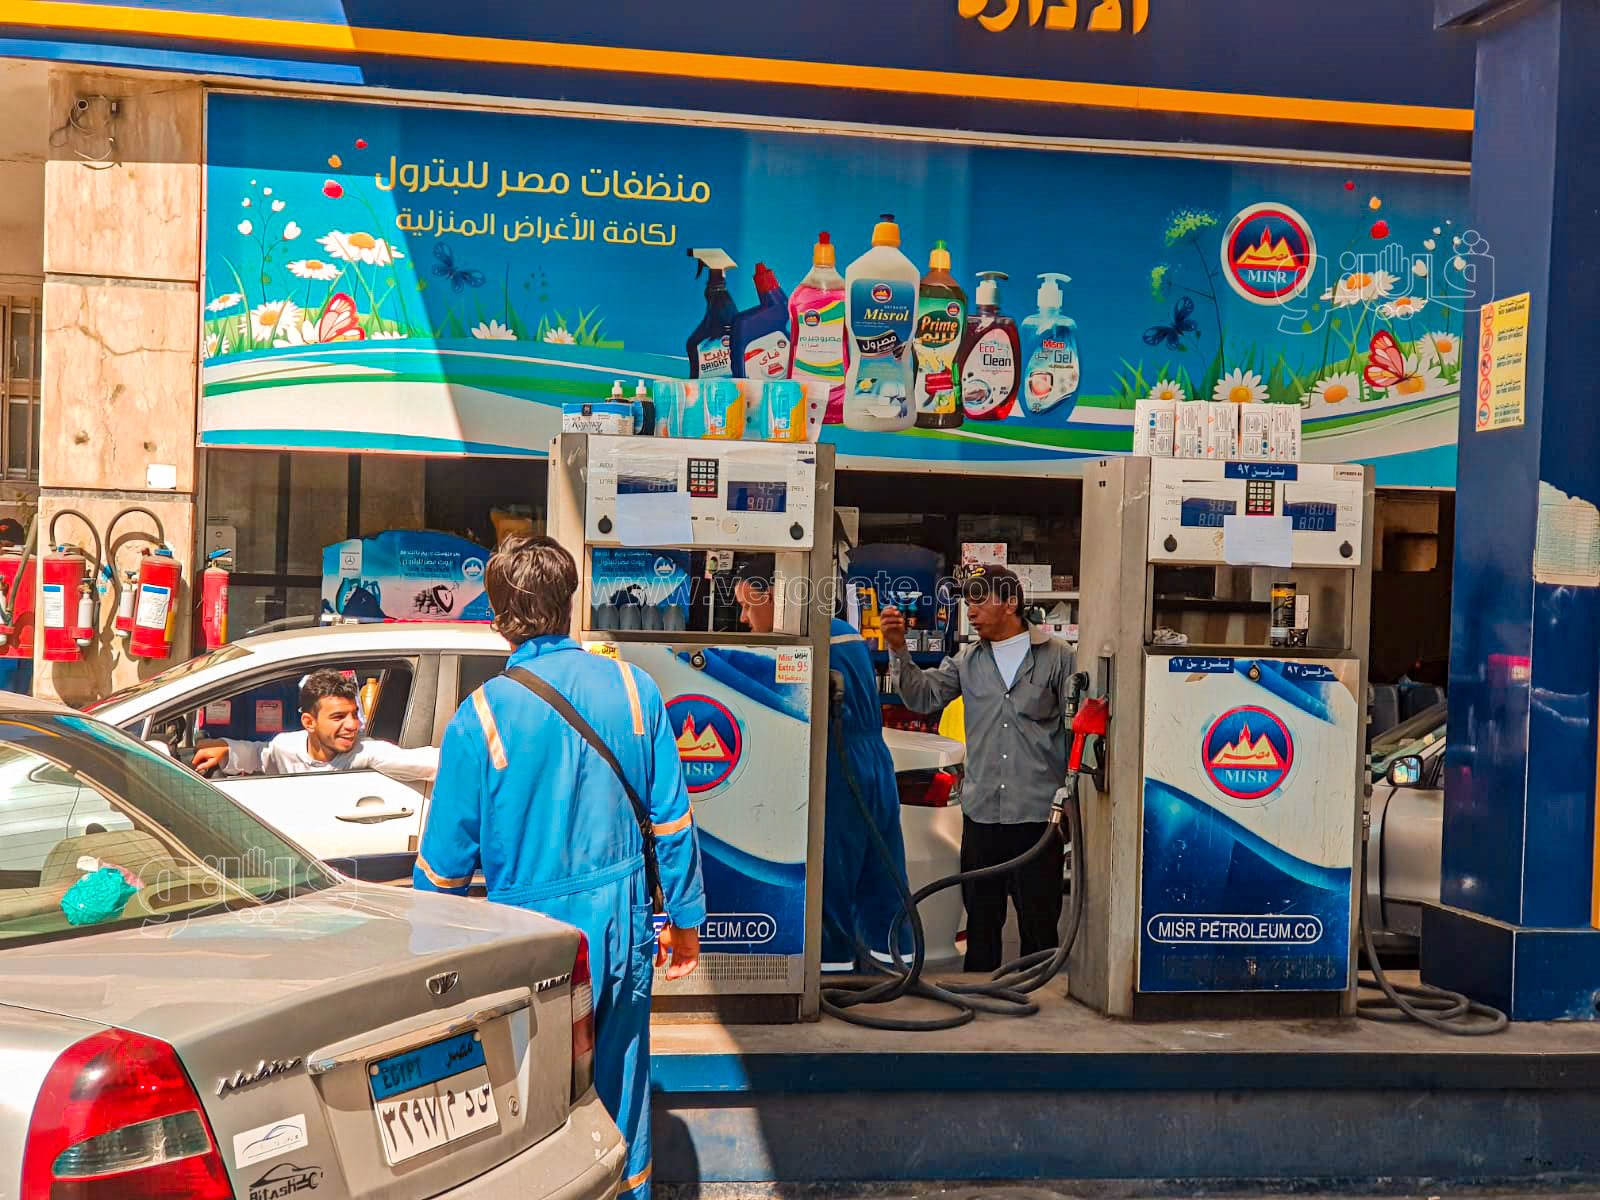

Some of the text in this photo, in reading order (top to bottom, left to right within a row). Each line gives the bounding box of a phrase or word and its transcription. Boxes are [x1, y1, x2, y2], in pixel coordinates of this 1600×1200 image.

[375, 155, 711, 203] منظفات مصر للبترول
[395, 207, 676, 246] لكافة الأغراض المنزلية
[1247, 269, 1288, 284] MISR
[863, 307, 909, 322] Misrol
[921, 315, 958, 332] Prime
[862, 335, 897, 351] مصرول
[983, 354, 1011, 367] Clean
[1054, 350, 1072, 363] Gel
[701, 358, 729, 371] BRIGHT
[1238, 464, 1286, 478] بنزين ٩٢
[681, 763, 714, 776] ISR
[1224, 769, 1268, 784] MISR
[1158, 921, 1317, 939] MISR PETROLEUM.CO
[381, 1056, 422, 1089] EGYPT
